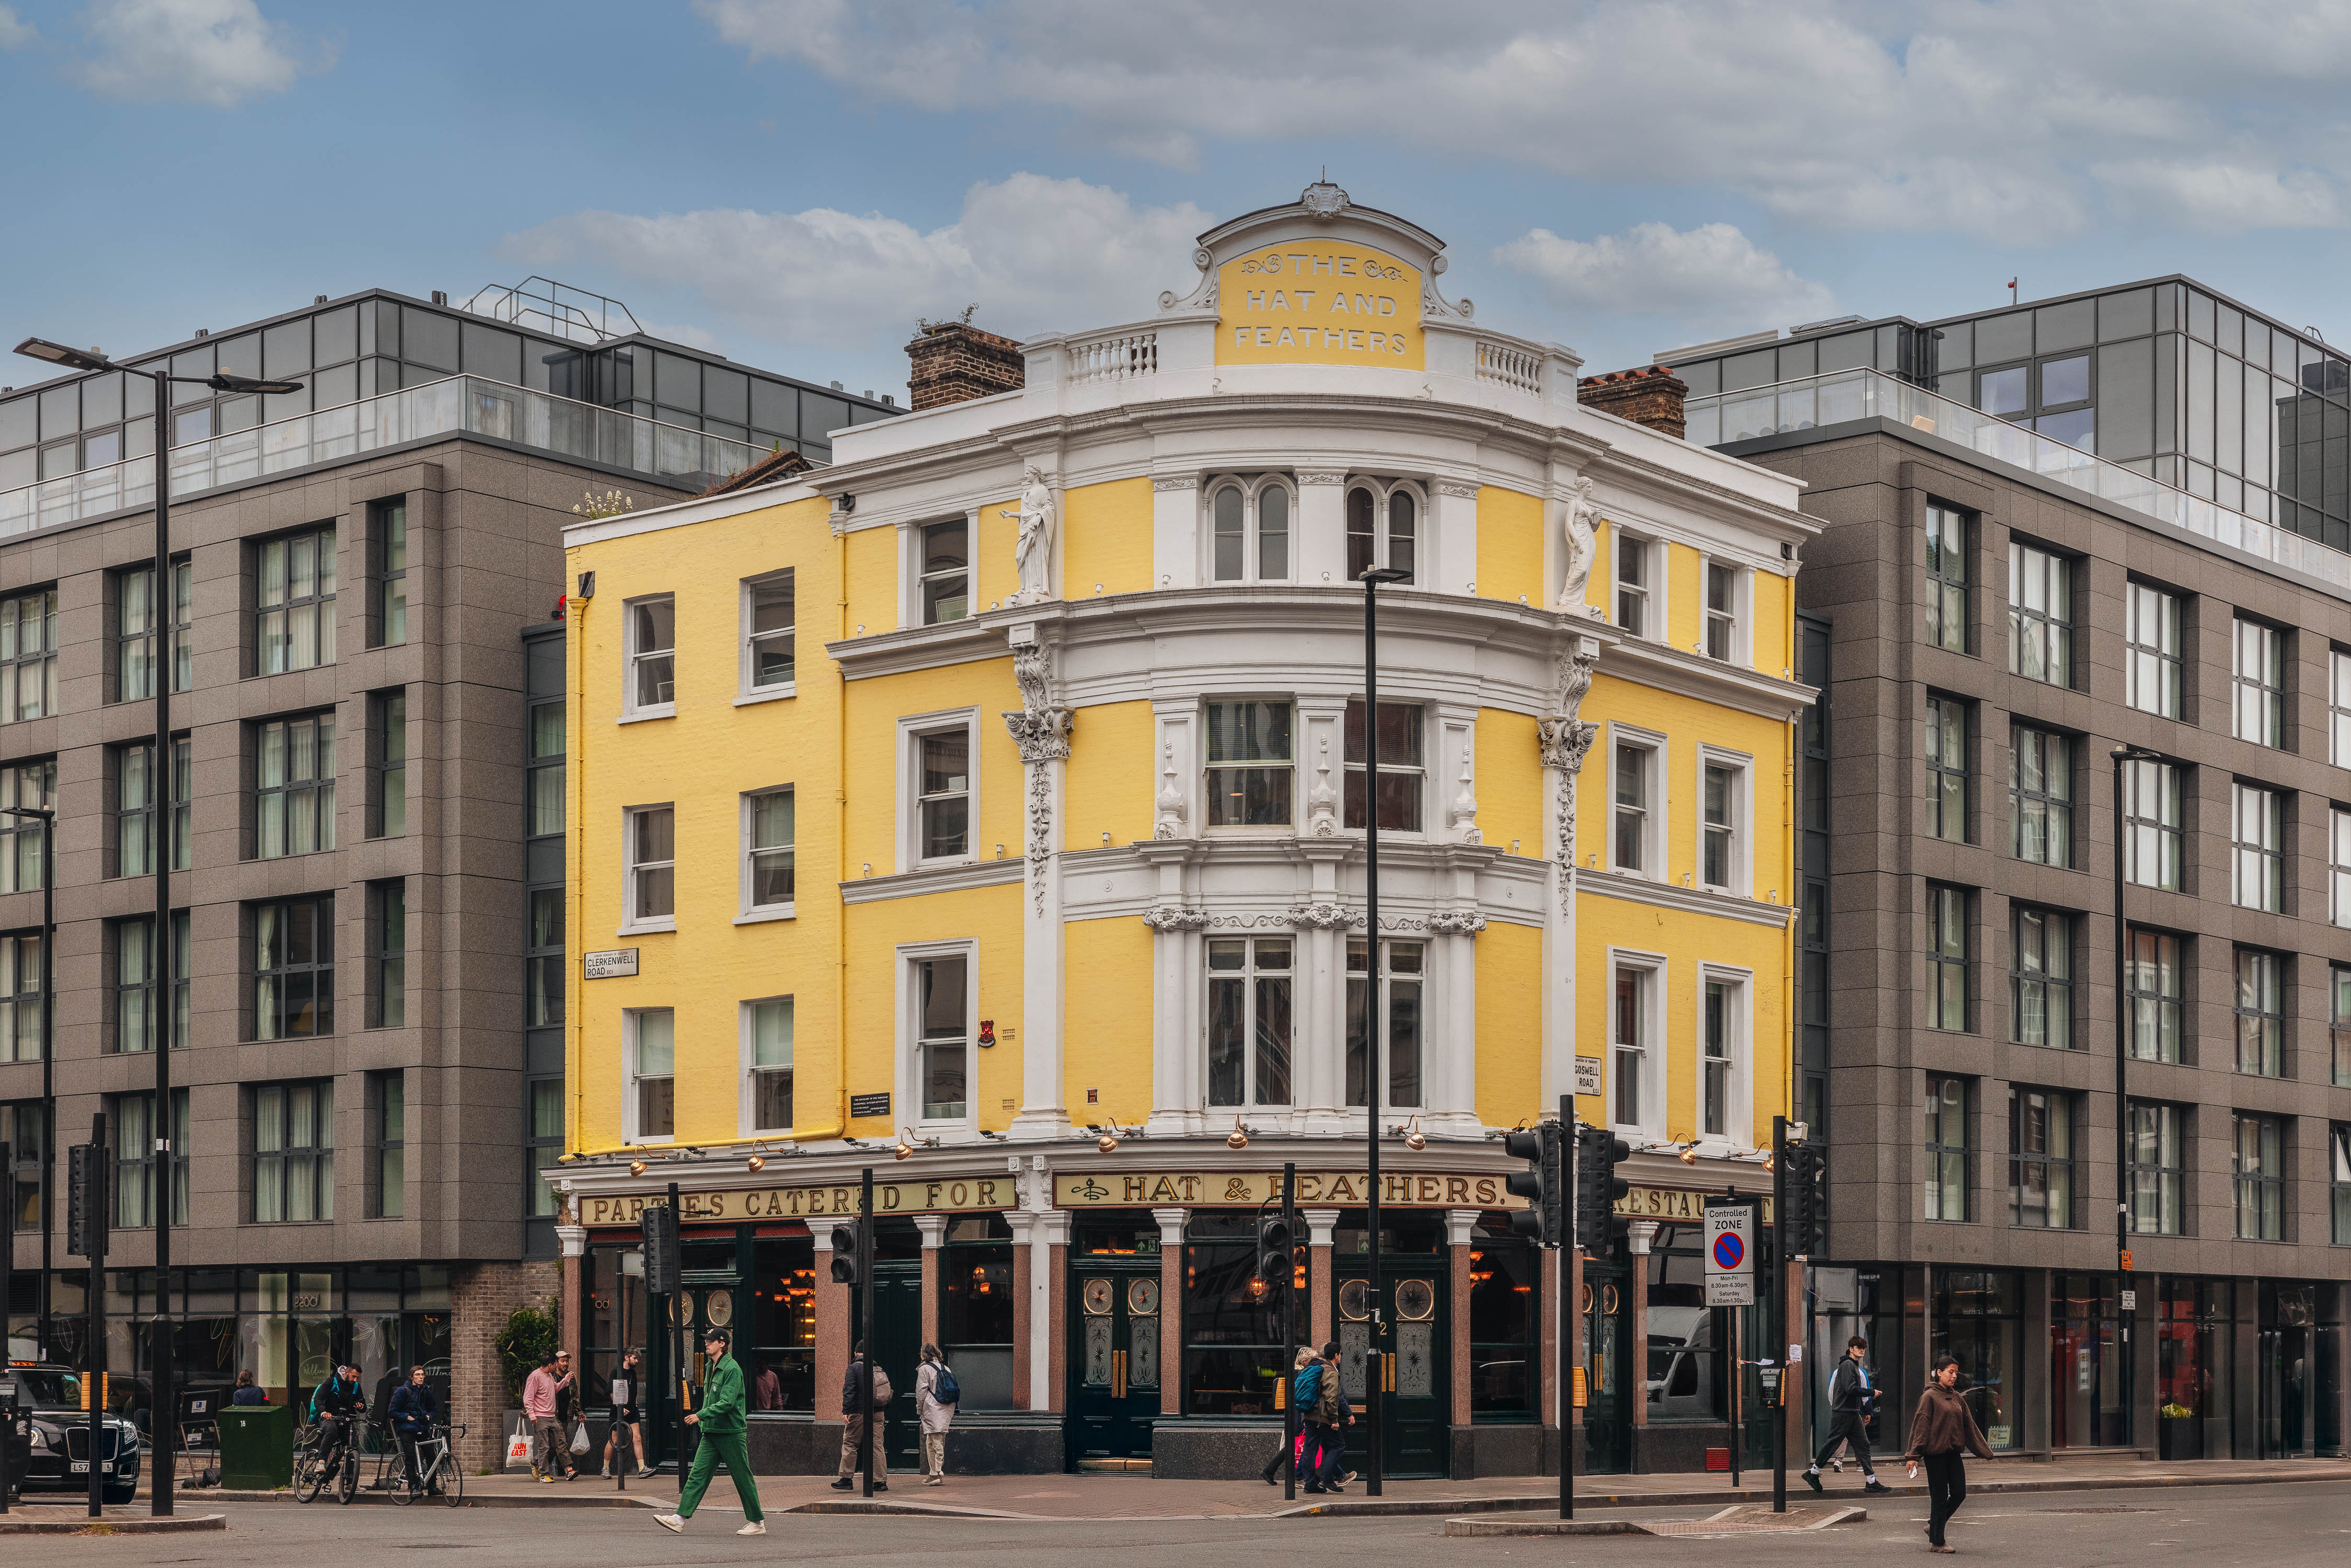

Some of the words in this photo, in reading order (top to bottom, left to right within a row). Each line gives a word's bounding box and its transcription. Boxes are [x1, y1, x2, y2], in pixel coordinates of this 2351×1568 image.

[1287, 254, 1356, 277] THE
[1247, 290, 1316, 311] HAT
[1329, 292, 1396, 317] AND
[1235, 326, 1405, 355] FEATHERS
[587, 955, 634, 967] CLERKENWELL
[587, 967, 605, 976] ROAD
[1575, 1065, 1599, 1076] GOSWELL
[1579, 1077, 1593, 1088] ROAD
[1123, 1175, 1201, 1202] HAT
[1224, 1177, 1252, 1202] &
[594, 1194, 723, 1222] PARES
[745, 1186, 900, 1215] CATERD
[926, 1180, 996, 1208] FOR
[1612, 1189, 1770, 1220] ESTAUT
[1709, 1209, 1747, 1218] Controlled
[1715, 1220, 1742, 1230] ZONE
[1380, 1322, 1387, 1335] 2
